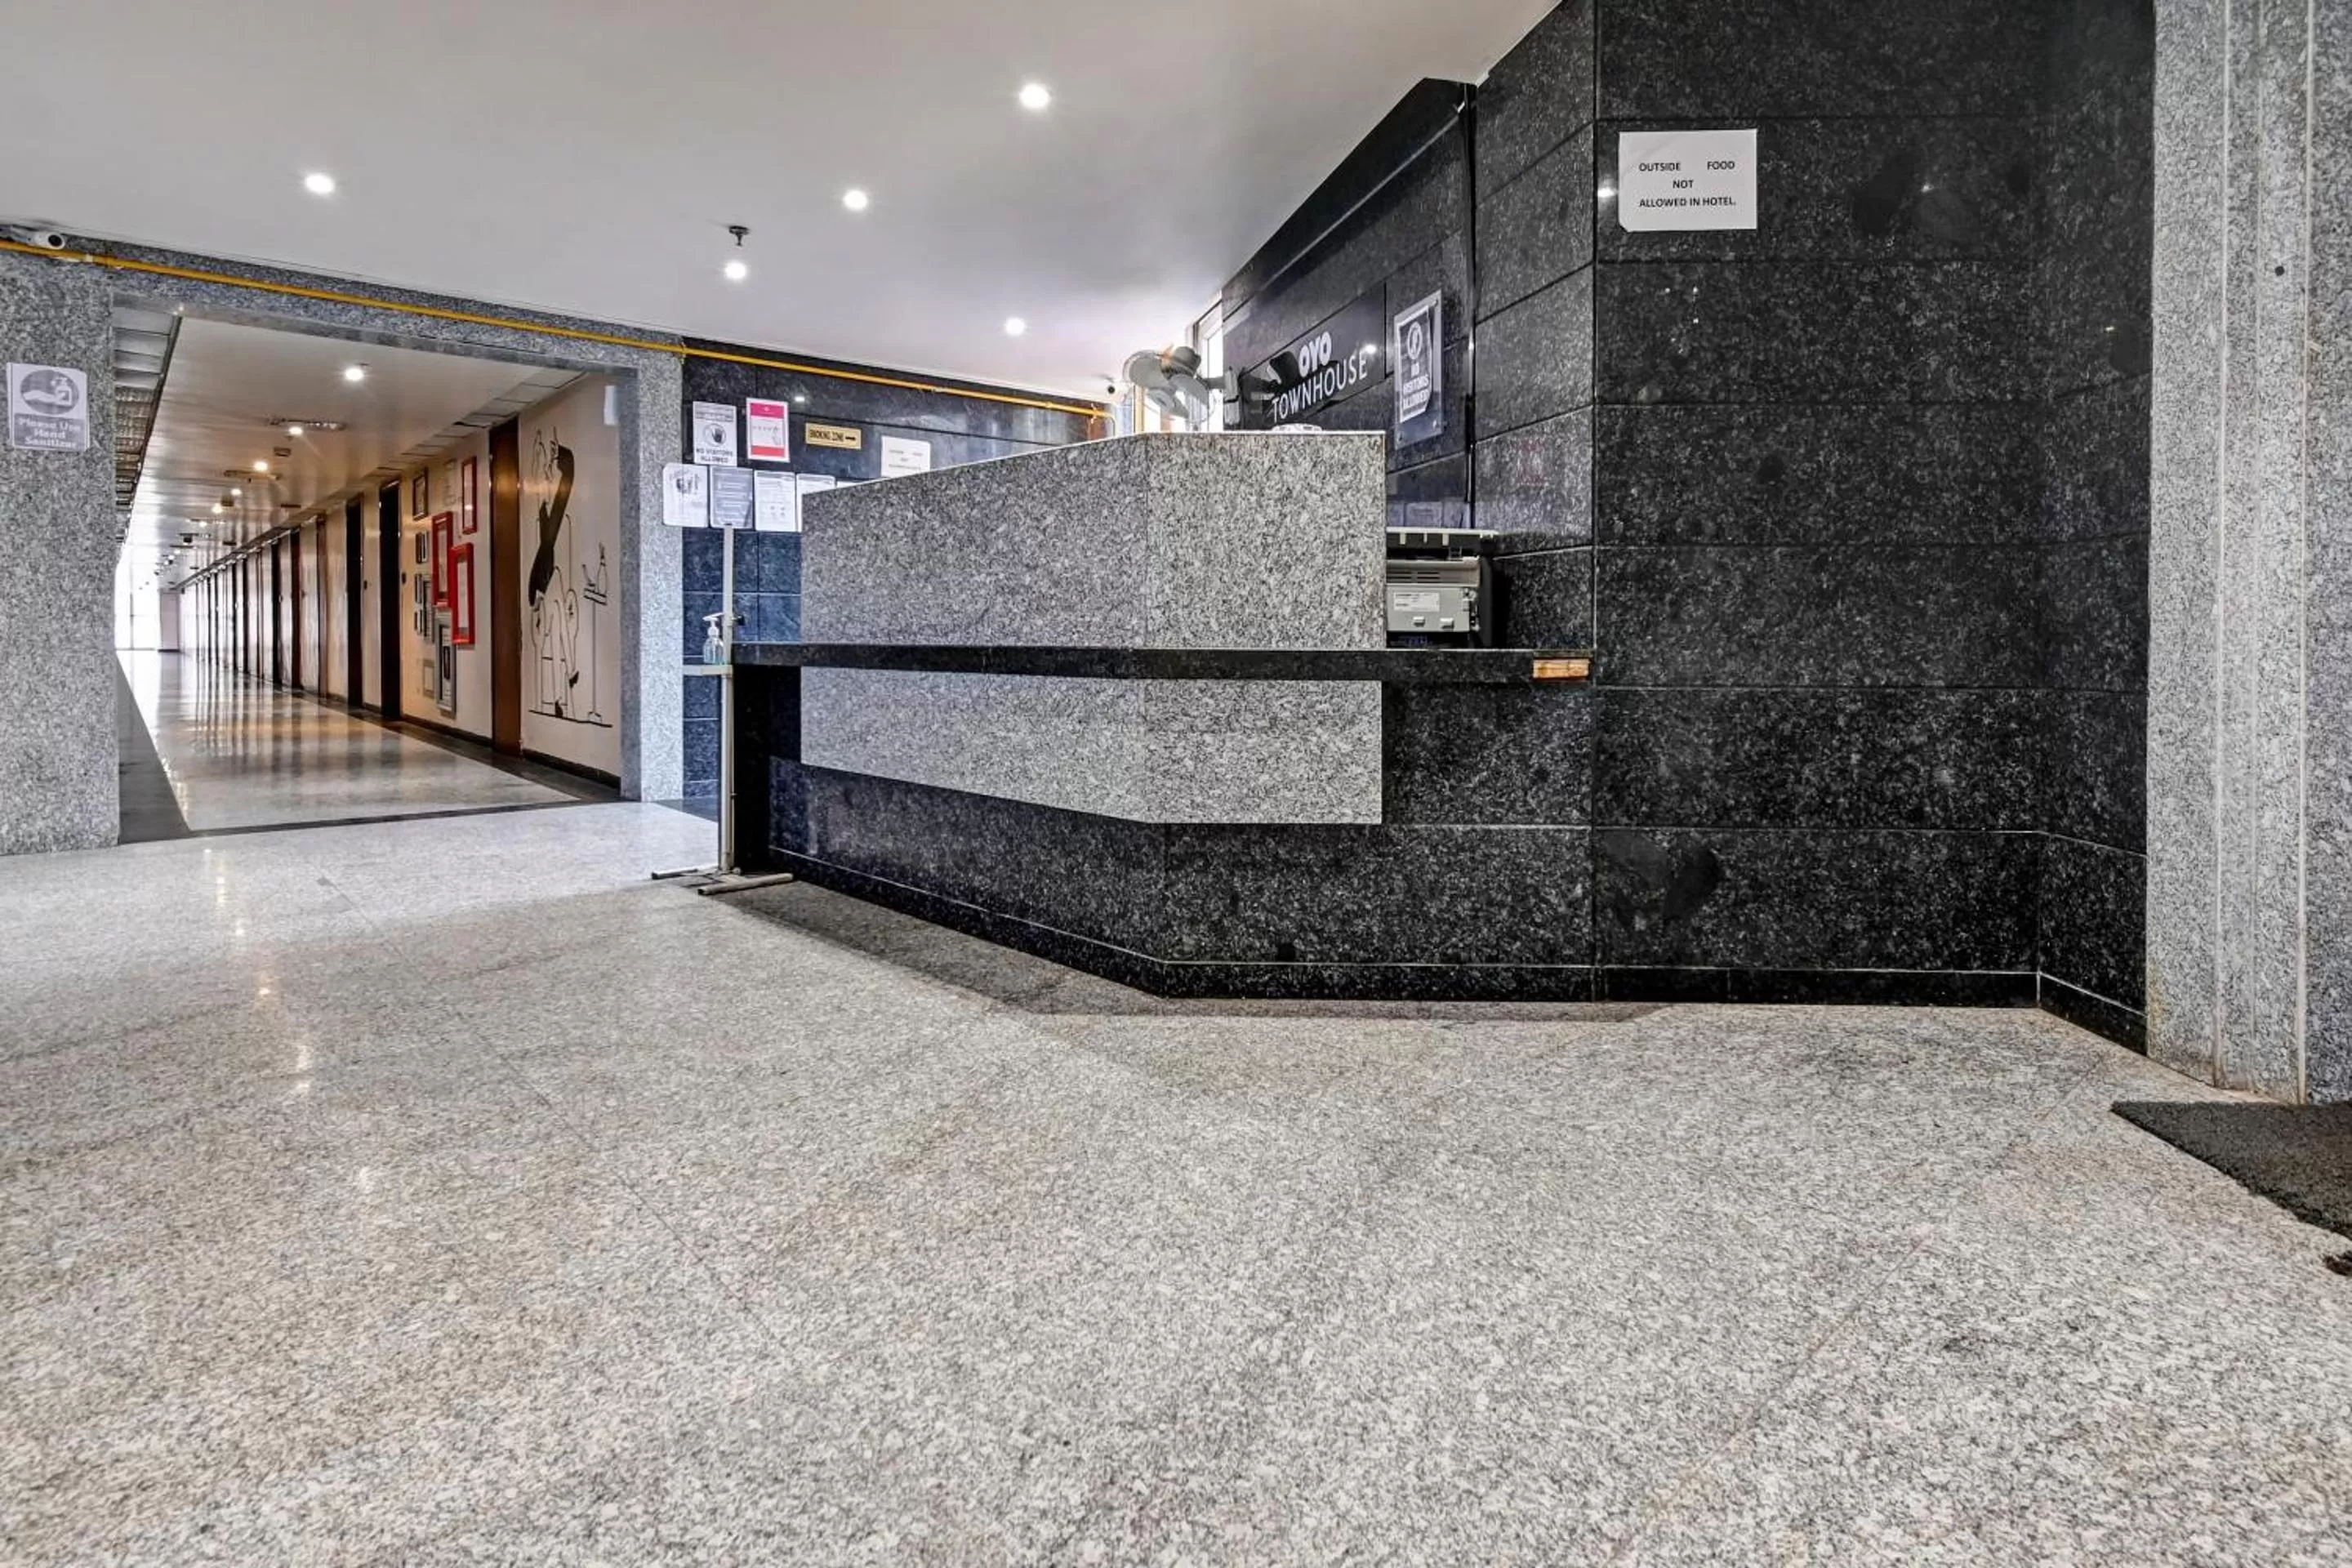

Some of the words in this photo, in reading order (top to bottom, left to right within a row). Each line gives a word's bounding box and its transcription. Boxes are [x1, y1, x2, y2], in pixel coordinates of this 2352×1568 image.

[1638, 163, 1681, 172] OUTSIDE
[1707, 161, 1735, 170] FOOD
[1673, 180, 1694, 189] NOT
[1638, 198, 1686, 207] ALLOWED
[1690, 197, 1700, 207] IN
[1298, 332, 1331, 378] OYO
[1272, 349, 1368, 424] TOWNHOUSE
